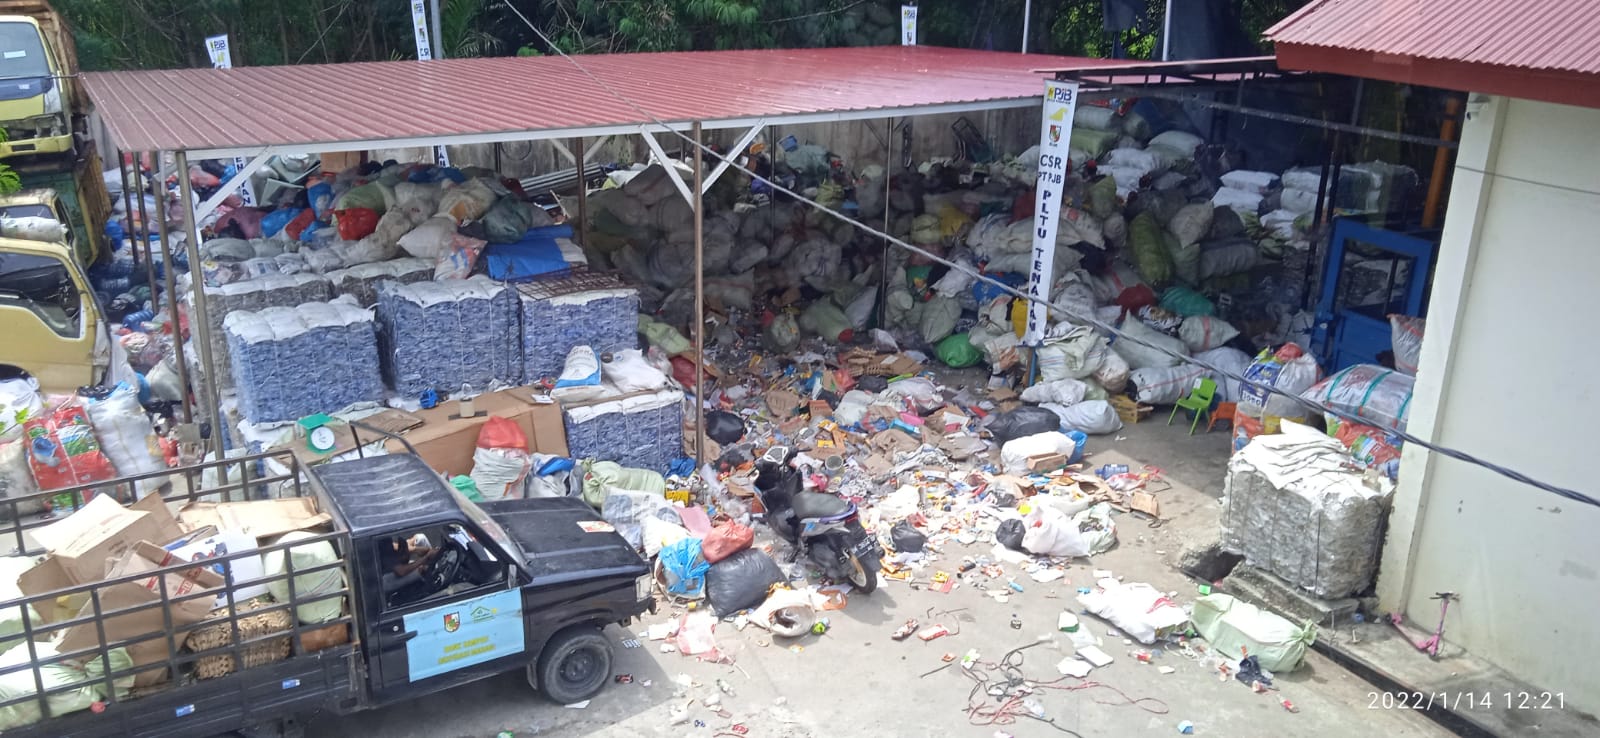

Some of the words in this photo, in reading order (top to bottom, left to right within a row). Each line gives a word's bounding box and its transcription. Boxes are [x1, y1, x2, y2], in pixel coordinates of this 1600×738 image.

[1040, 154, 1062, 170] CSR
[1037, 171, 1048, 181] PT
[1048, 172, 1062, 184] PJB
[1037, 189, 1052, 239] PLTU
